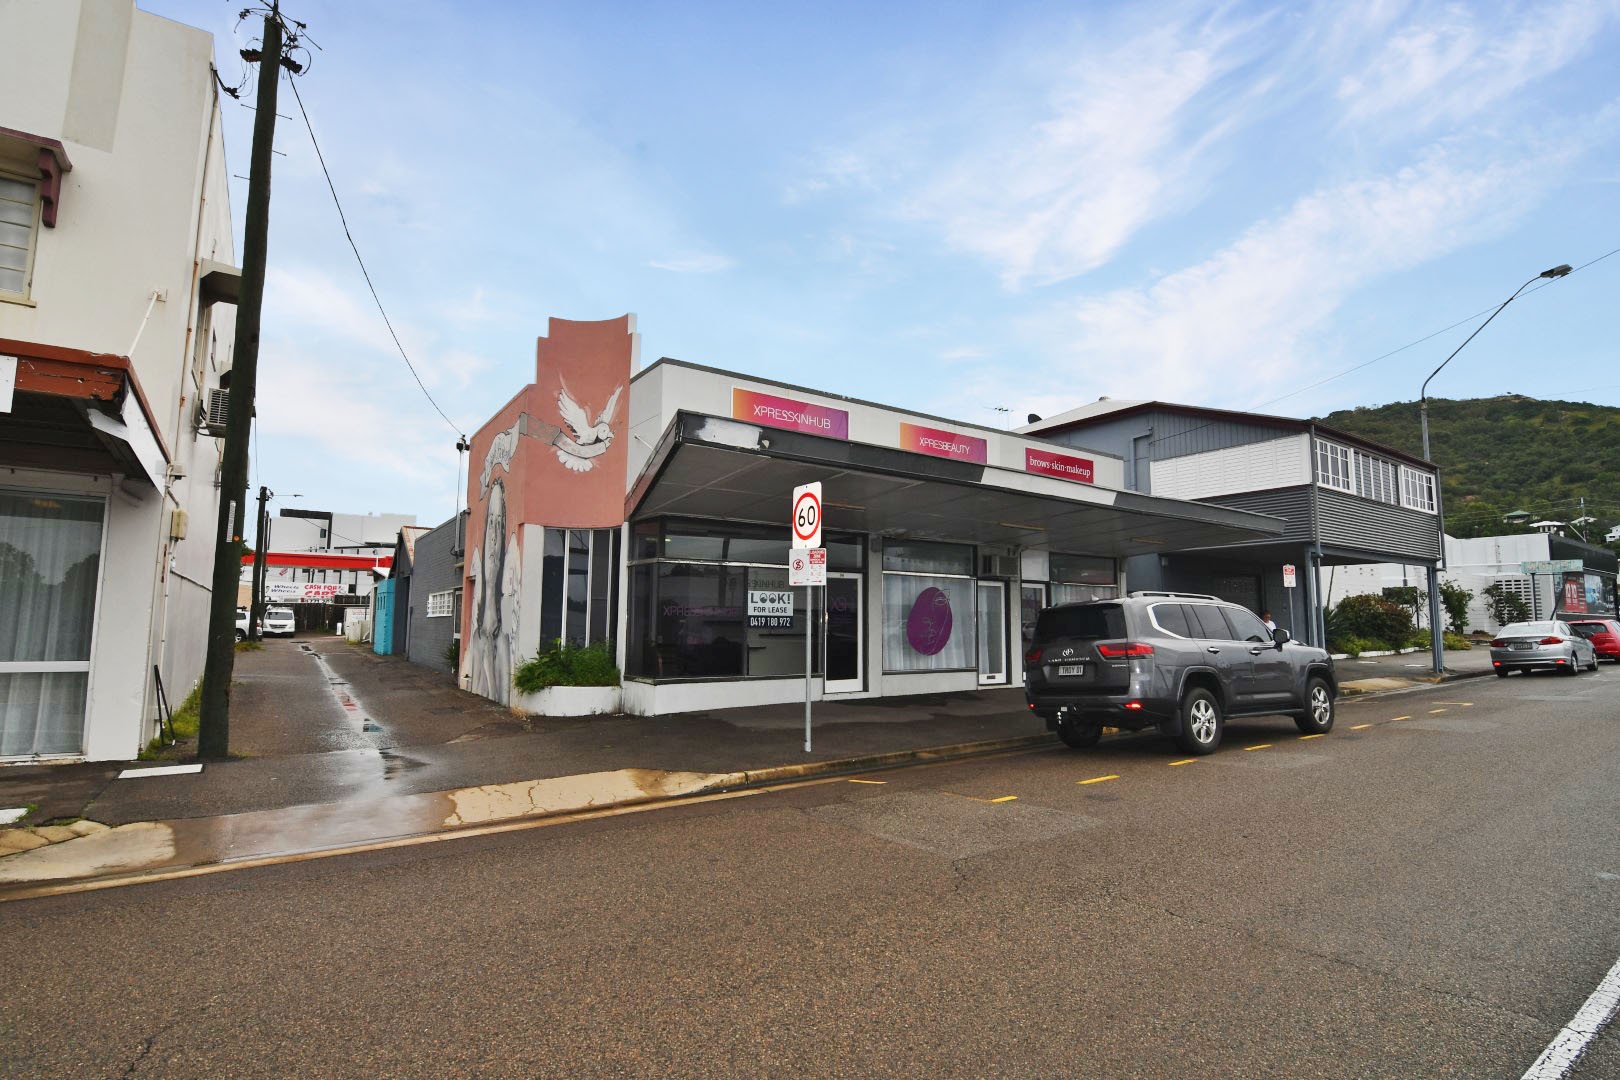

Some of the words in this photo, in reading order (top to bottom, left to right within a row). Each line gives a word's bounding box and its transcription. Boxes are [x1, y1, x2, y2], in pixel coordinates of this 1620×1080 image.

[798, 505, 816, 528] 60
[751, 593, 790, 604] LOOK!
[768, 606, 787, 614] LEASE
[751, 617, 765, 627] 0419
[780, 617, 790, 627] 972
